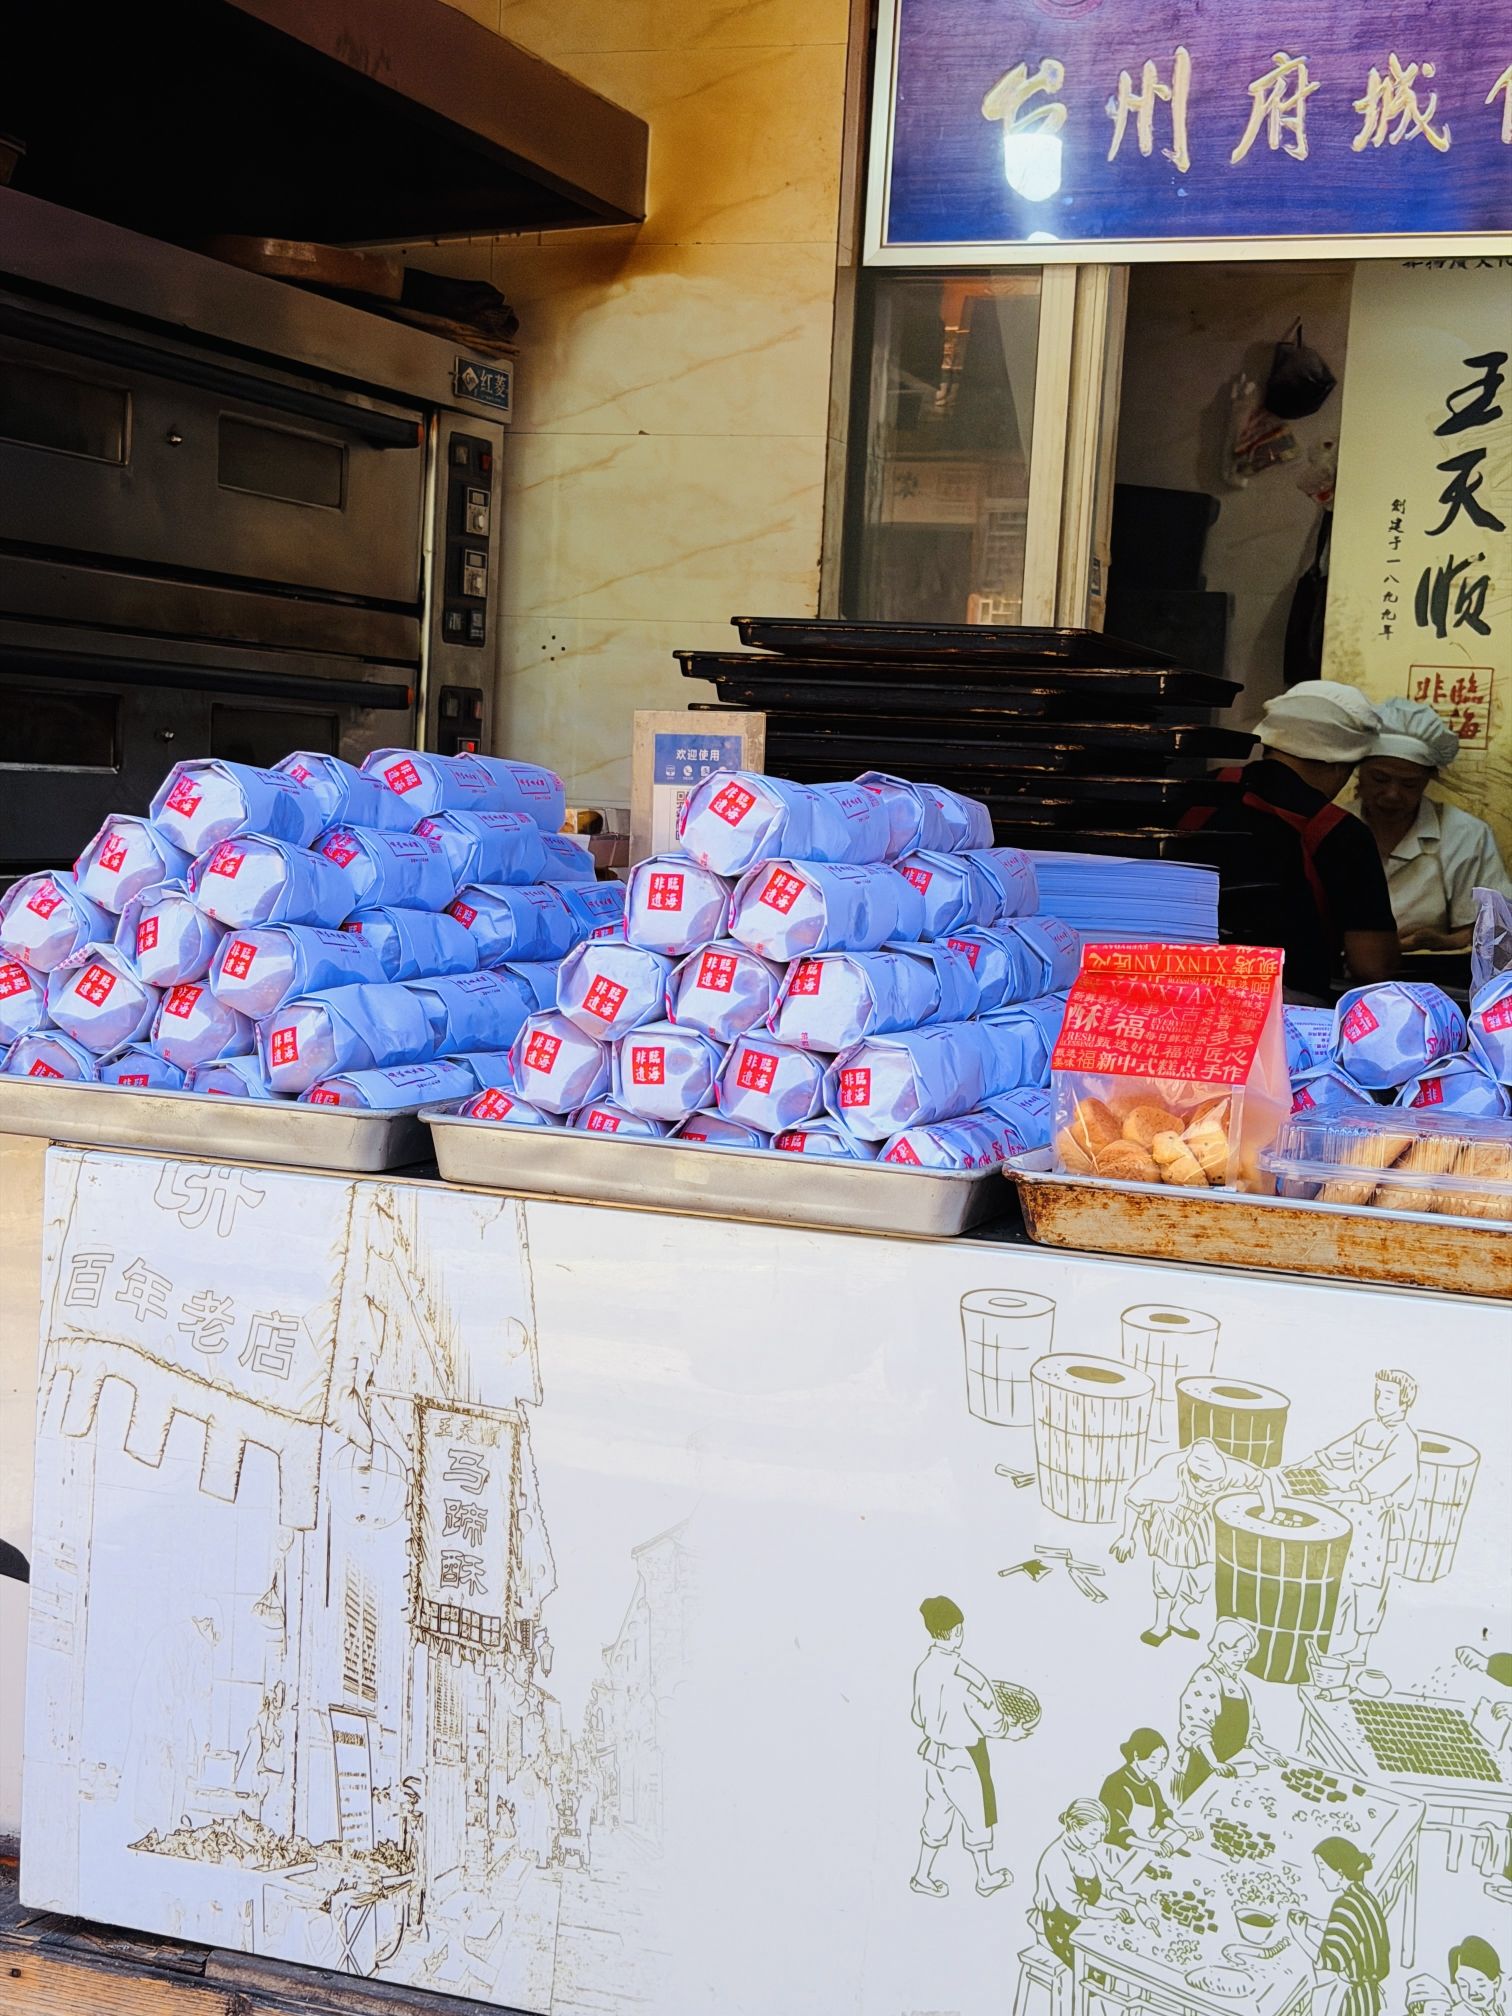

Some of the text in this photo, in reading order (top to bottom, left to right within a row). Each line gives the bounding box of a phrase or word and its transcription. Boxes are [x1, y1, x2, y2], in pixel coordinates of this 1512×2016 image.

[676, 749, 720, 761] 欢迎使用
[1107, 1013, 1150, 1040] 福
[1077, 1049, 1096, 1069] 福
[1096, 1051, 1198, 1078] 新中式糕点
[1203, 1047, 1249, 1065] 匠心
[1200, 1064, 1245, 1082] 手作
[63, 1252, 303, 1380] 百年老店
[440, 1448, 490, 1597] 马蹄酥
